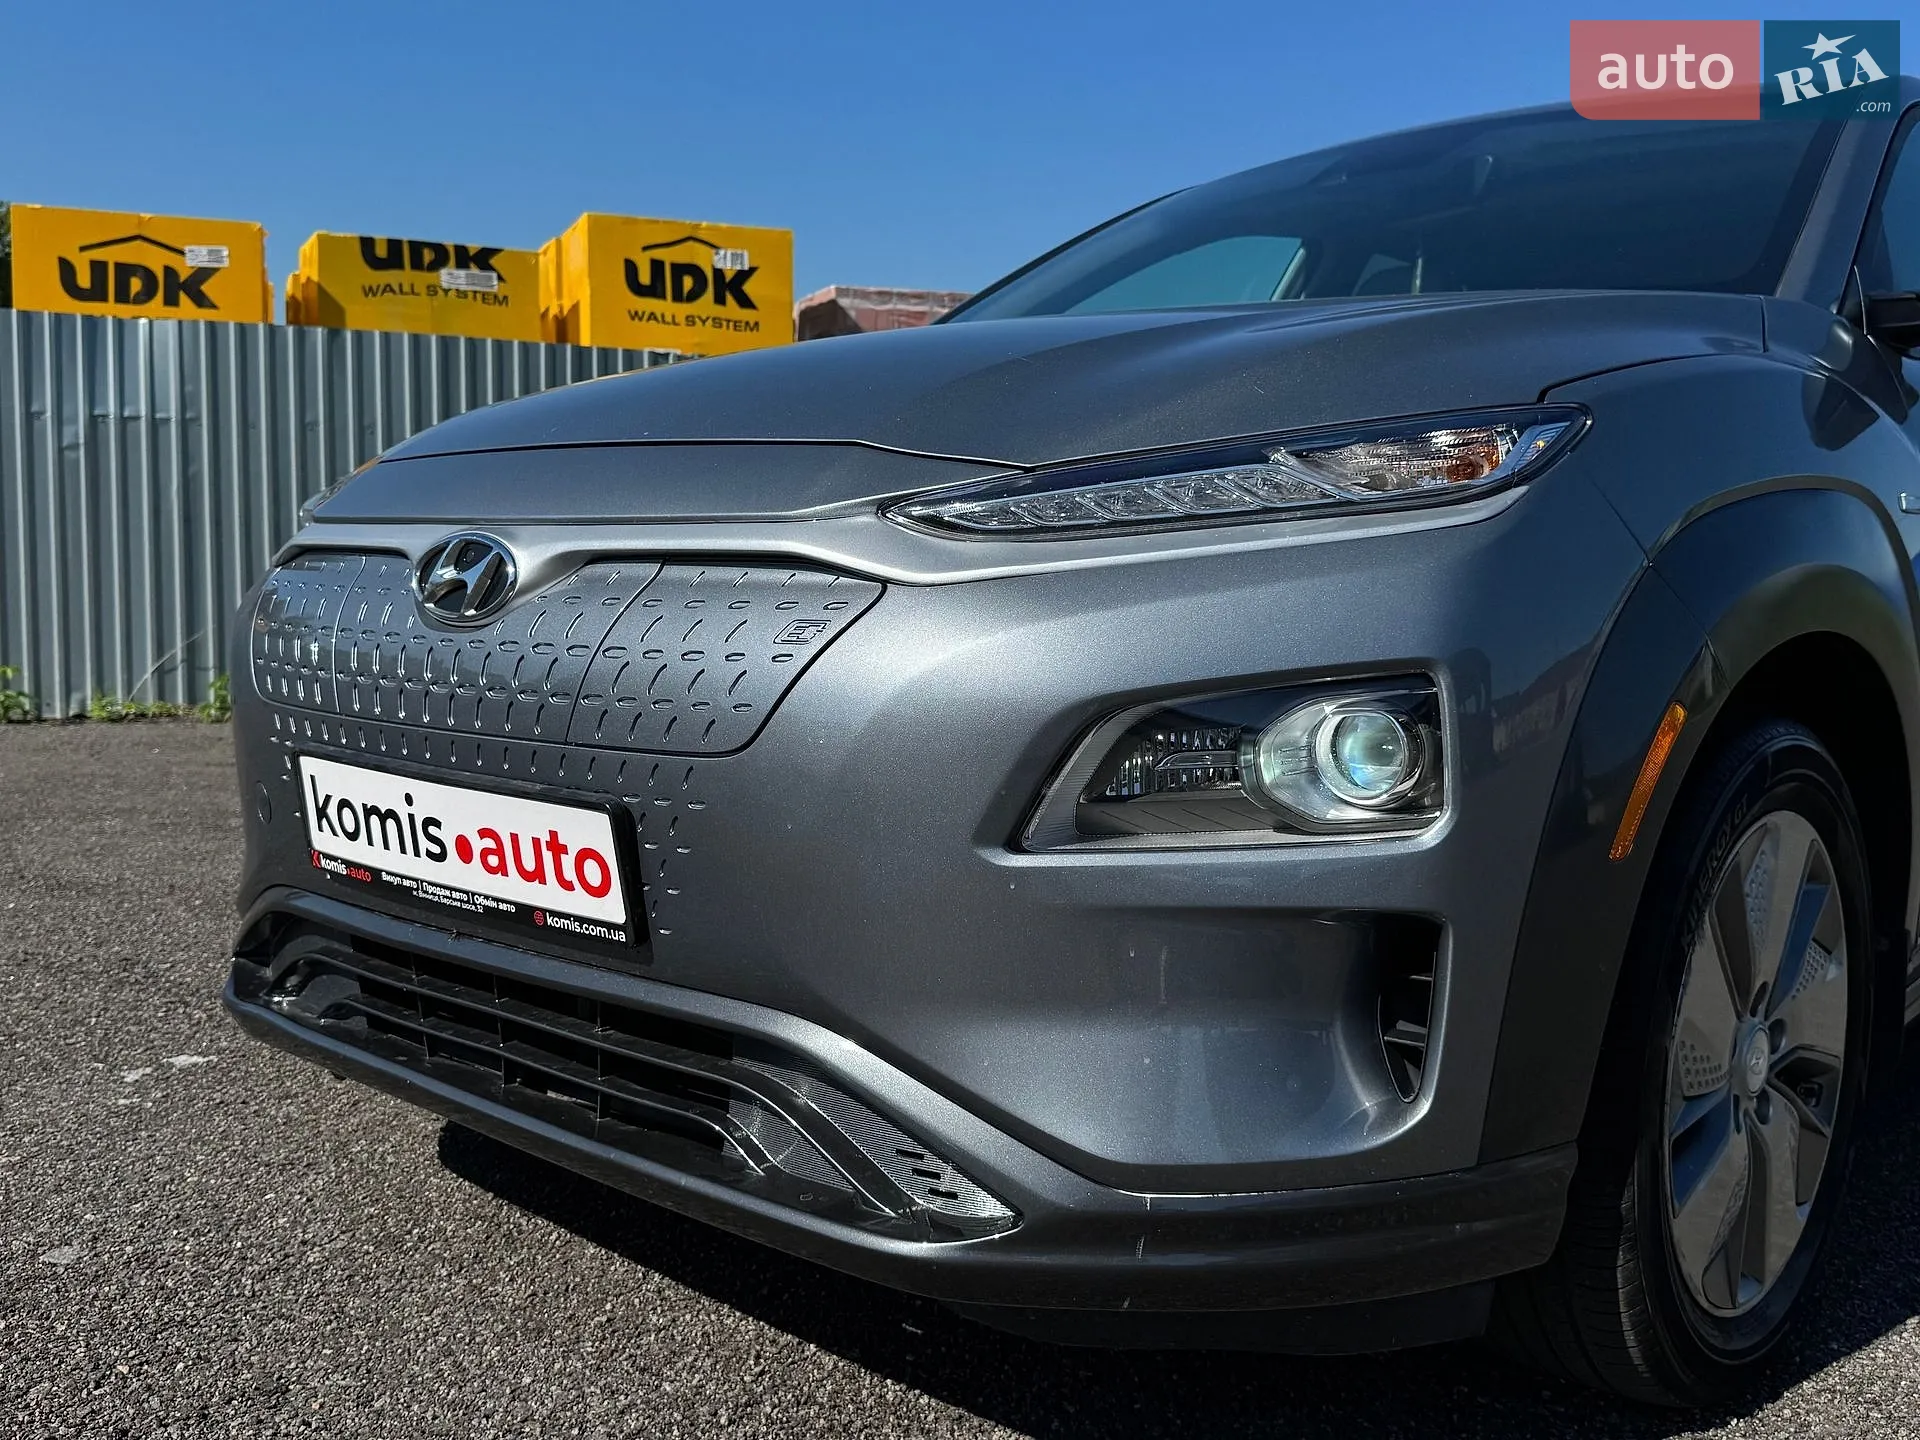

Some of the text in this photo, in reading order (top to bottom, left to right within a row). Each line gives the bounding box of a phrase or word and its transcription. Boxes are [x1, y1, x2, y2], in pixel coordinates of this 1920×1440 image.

[58, 256, 221, 310] UDK
[362, 283, 509, 307] WALL SYSTEM
[624, 258, 760, 311] UDK
[627, 309, 760, 332] WALL SYSTEM
[402, 878, 418, 889] авто
[422, 882, 451, 897] Продаж
[451, 891, 468, 901] авто
[474, 895, 498, 908] Обмін
[498, 902, 516, 913] авто
[546, 911, 627, 942] komis.com.ua
